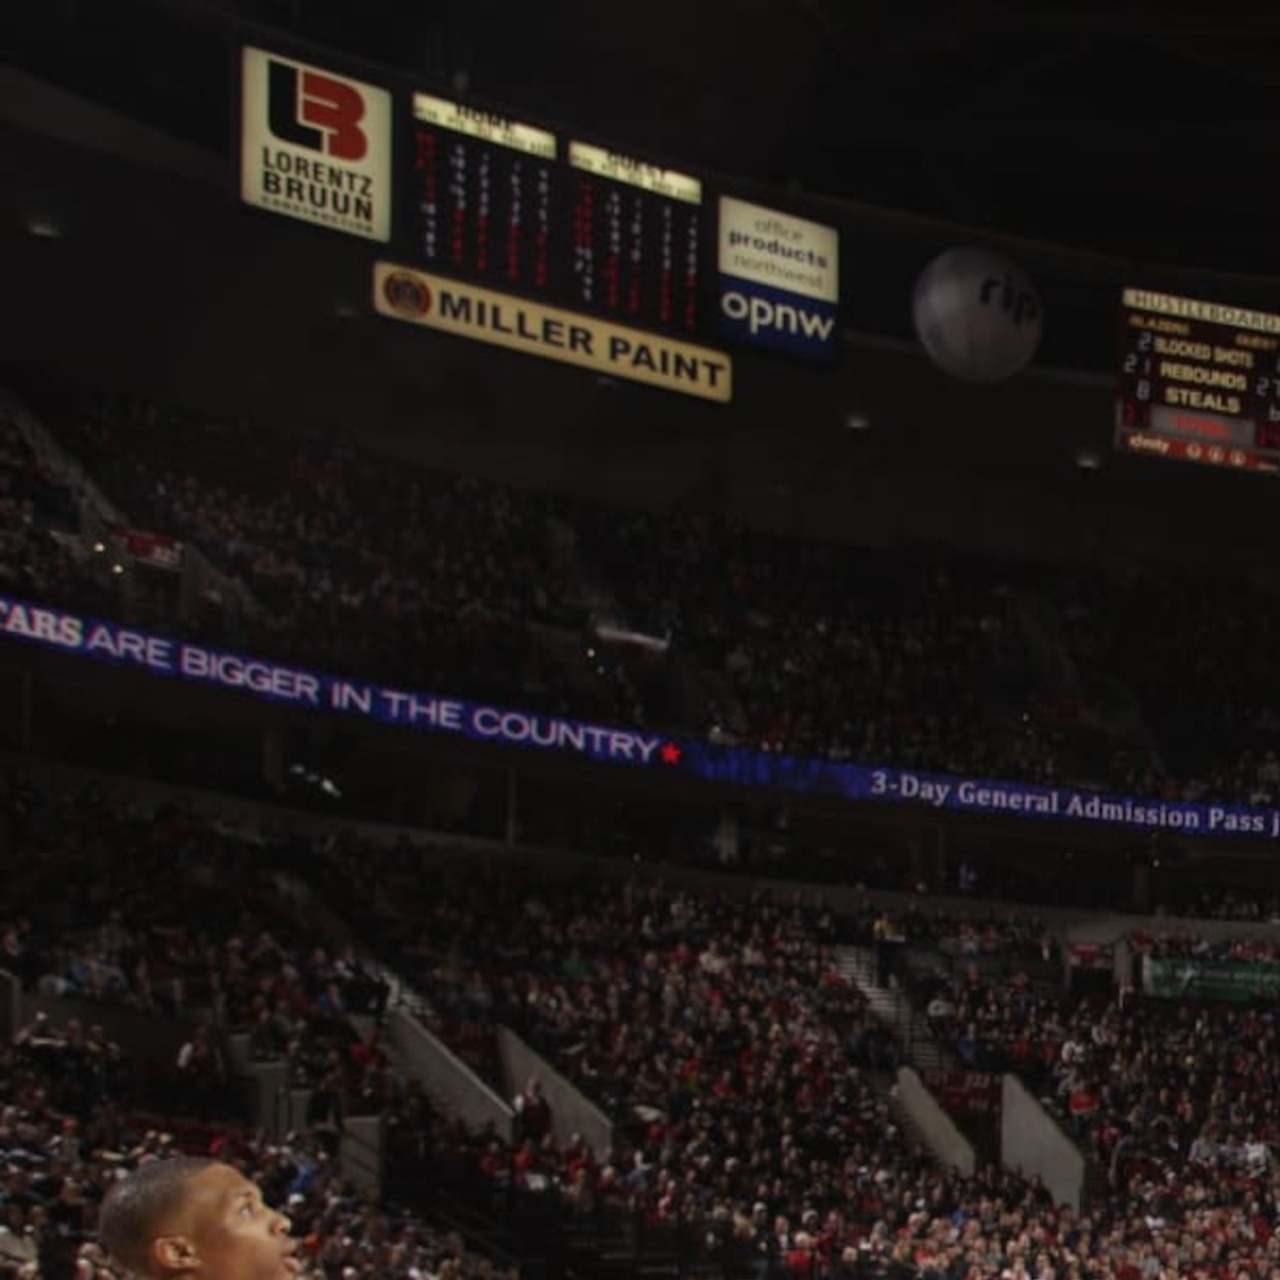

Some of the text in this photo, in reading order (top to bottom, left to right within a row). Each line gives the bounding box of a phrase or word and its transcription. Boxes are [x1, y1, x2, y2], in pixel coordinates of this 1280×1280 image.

[263, 146, 372, 199] LORENTZ
[263, 171, 373, 222] BRUUN
[729, 231, 827, 268] products
[440, 292, 725, 387] MILLER PAINT
[721, 291, 834, 342] opnw
[1160, 361, 1248, 392] REBOUNDS
[1163, 386, 1242, 413] STEALS
[87, 624, 172, 670] ARE
[180, 644, 321, 702] BIGGER
[330, 681, 371, 714] IN
[379, 689, 463, 730] THE
[472, 707, 658, 763] COUNTRY
[869, 770, 950, 808] 3-Day
[957, 781, 1059, 816] General
[1066, 794, 1199, 830] Admission
[1208, 807, 1265, 833] Pass
